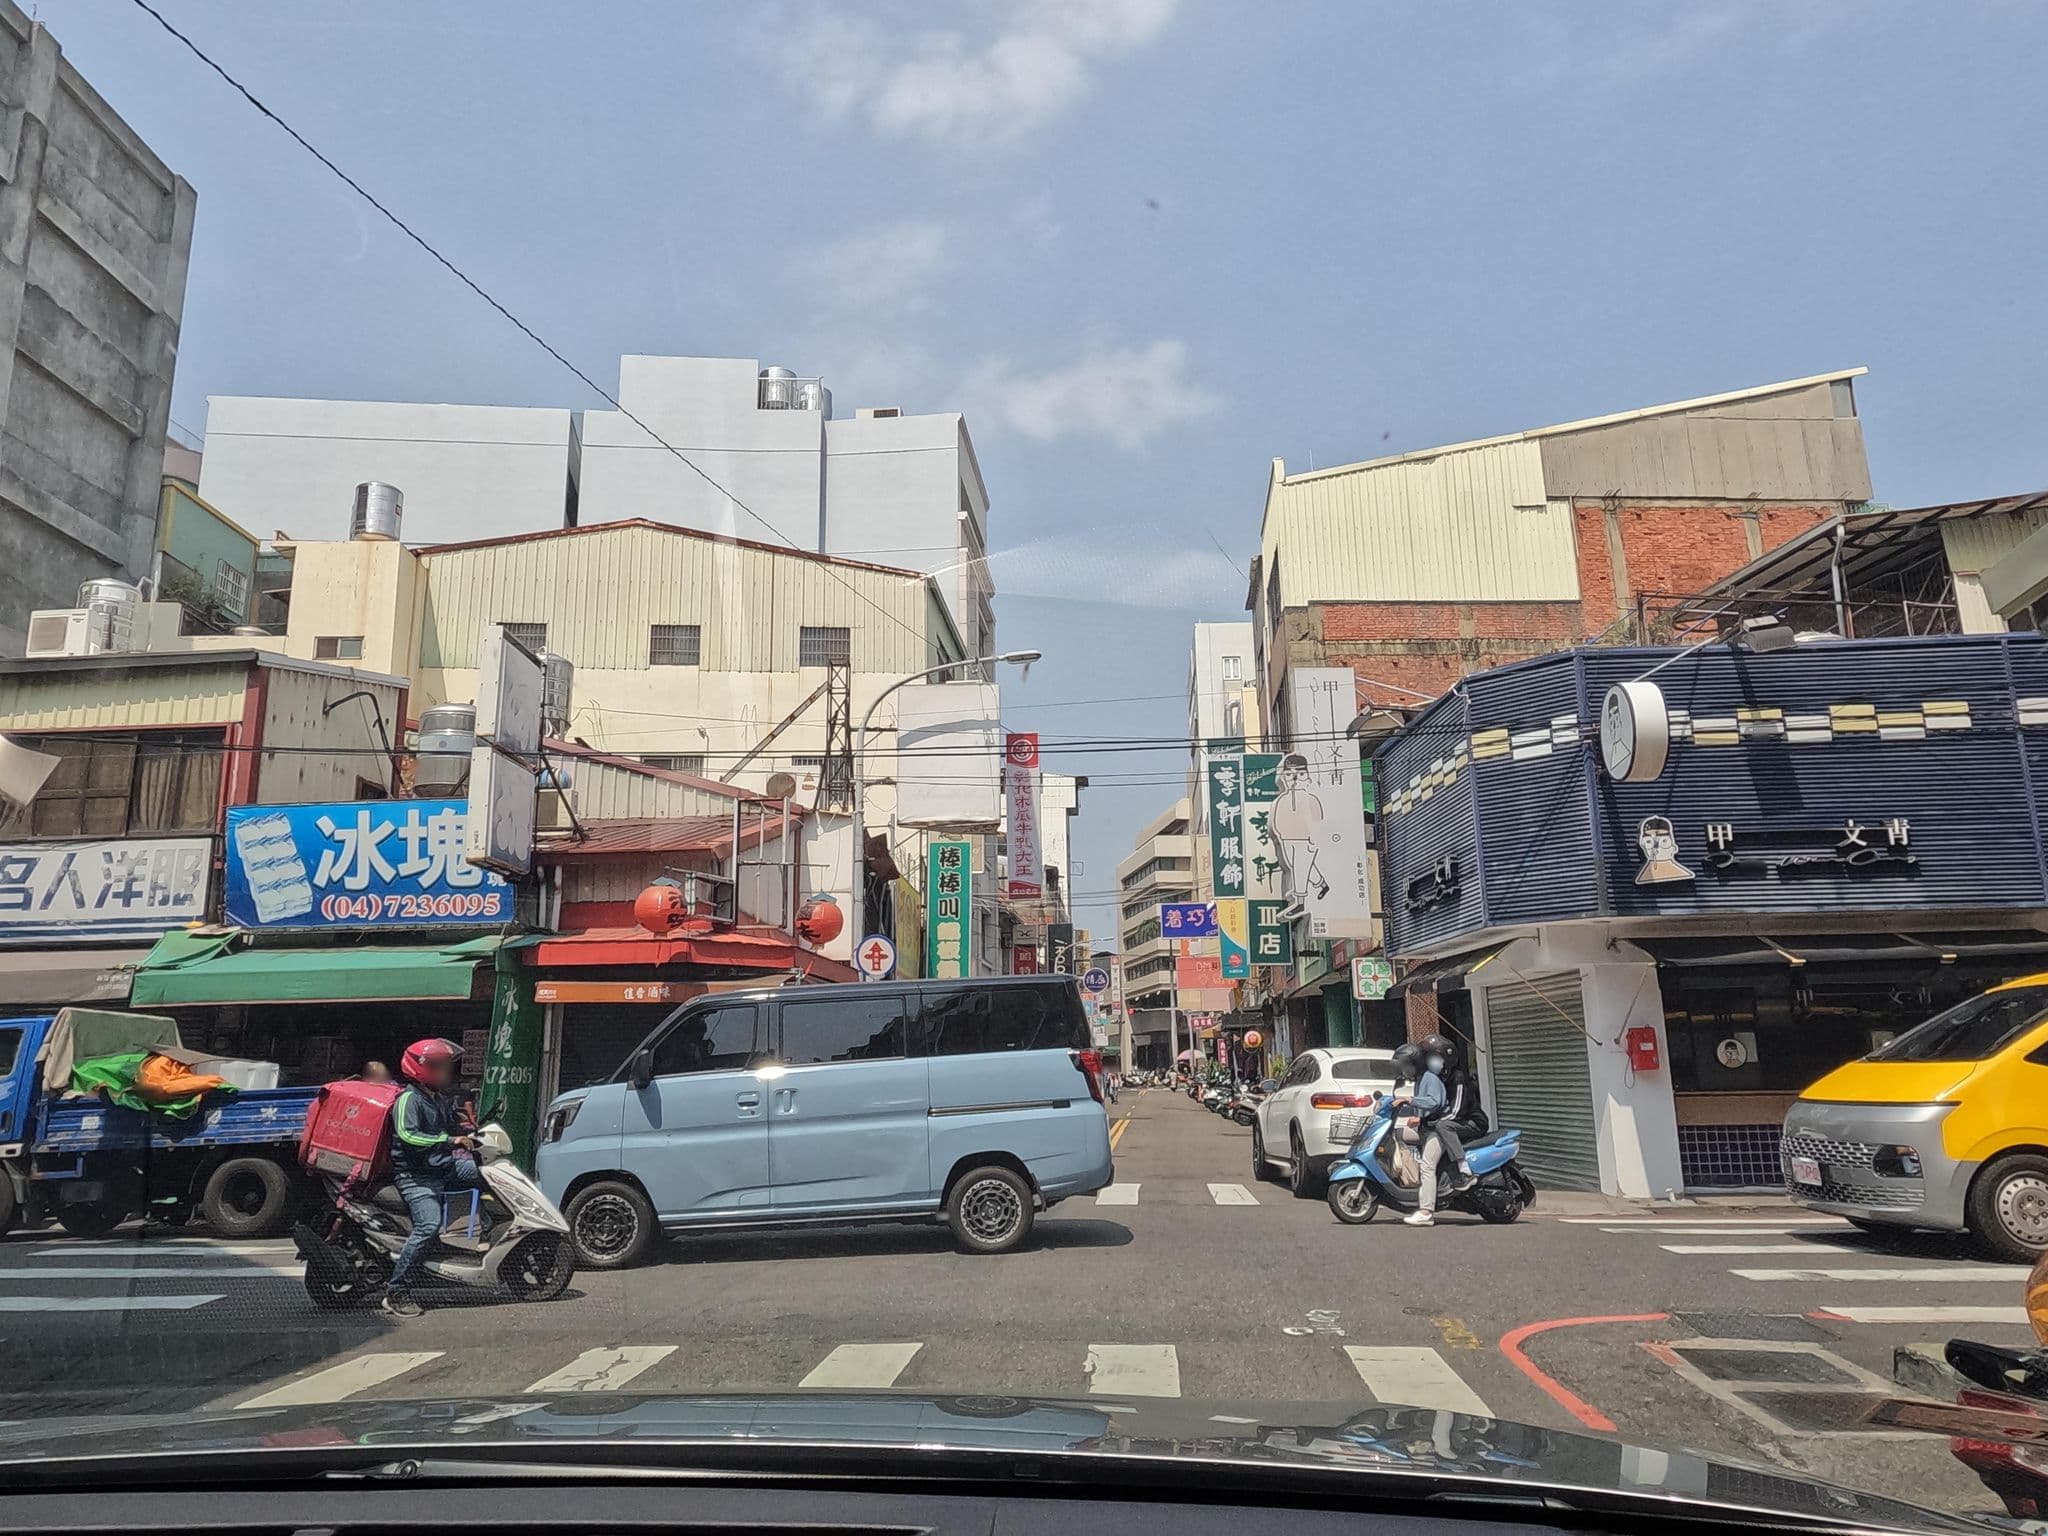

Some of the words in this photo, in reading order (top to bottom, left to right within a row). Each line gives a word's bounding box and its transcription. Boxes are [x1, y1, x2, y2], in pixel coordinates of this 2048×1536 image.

[313, 807, 484, 891] 冰塊
[937, 846, 962, 920] 棒棒叫
